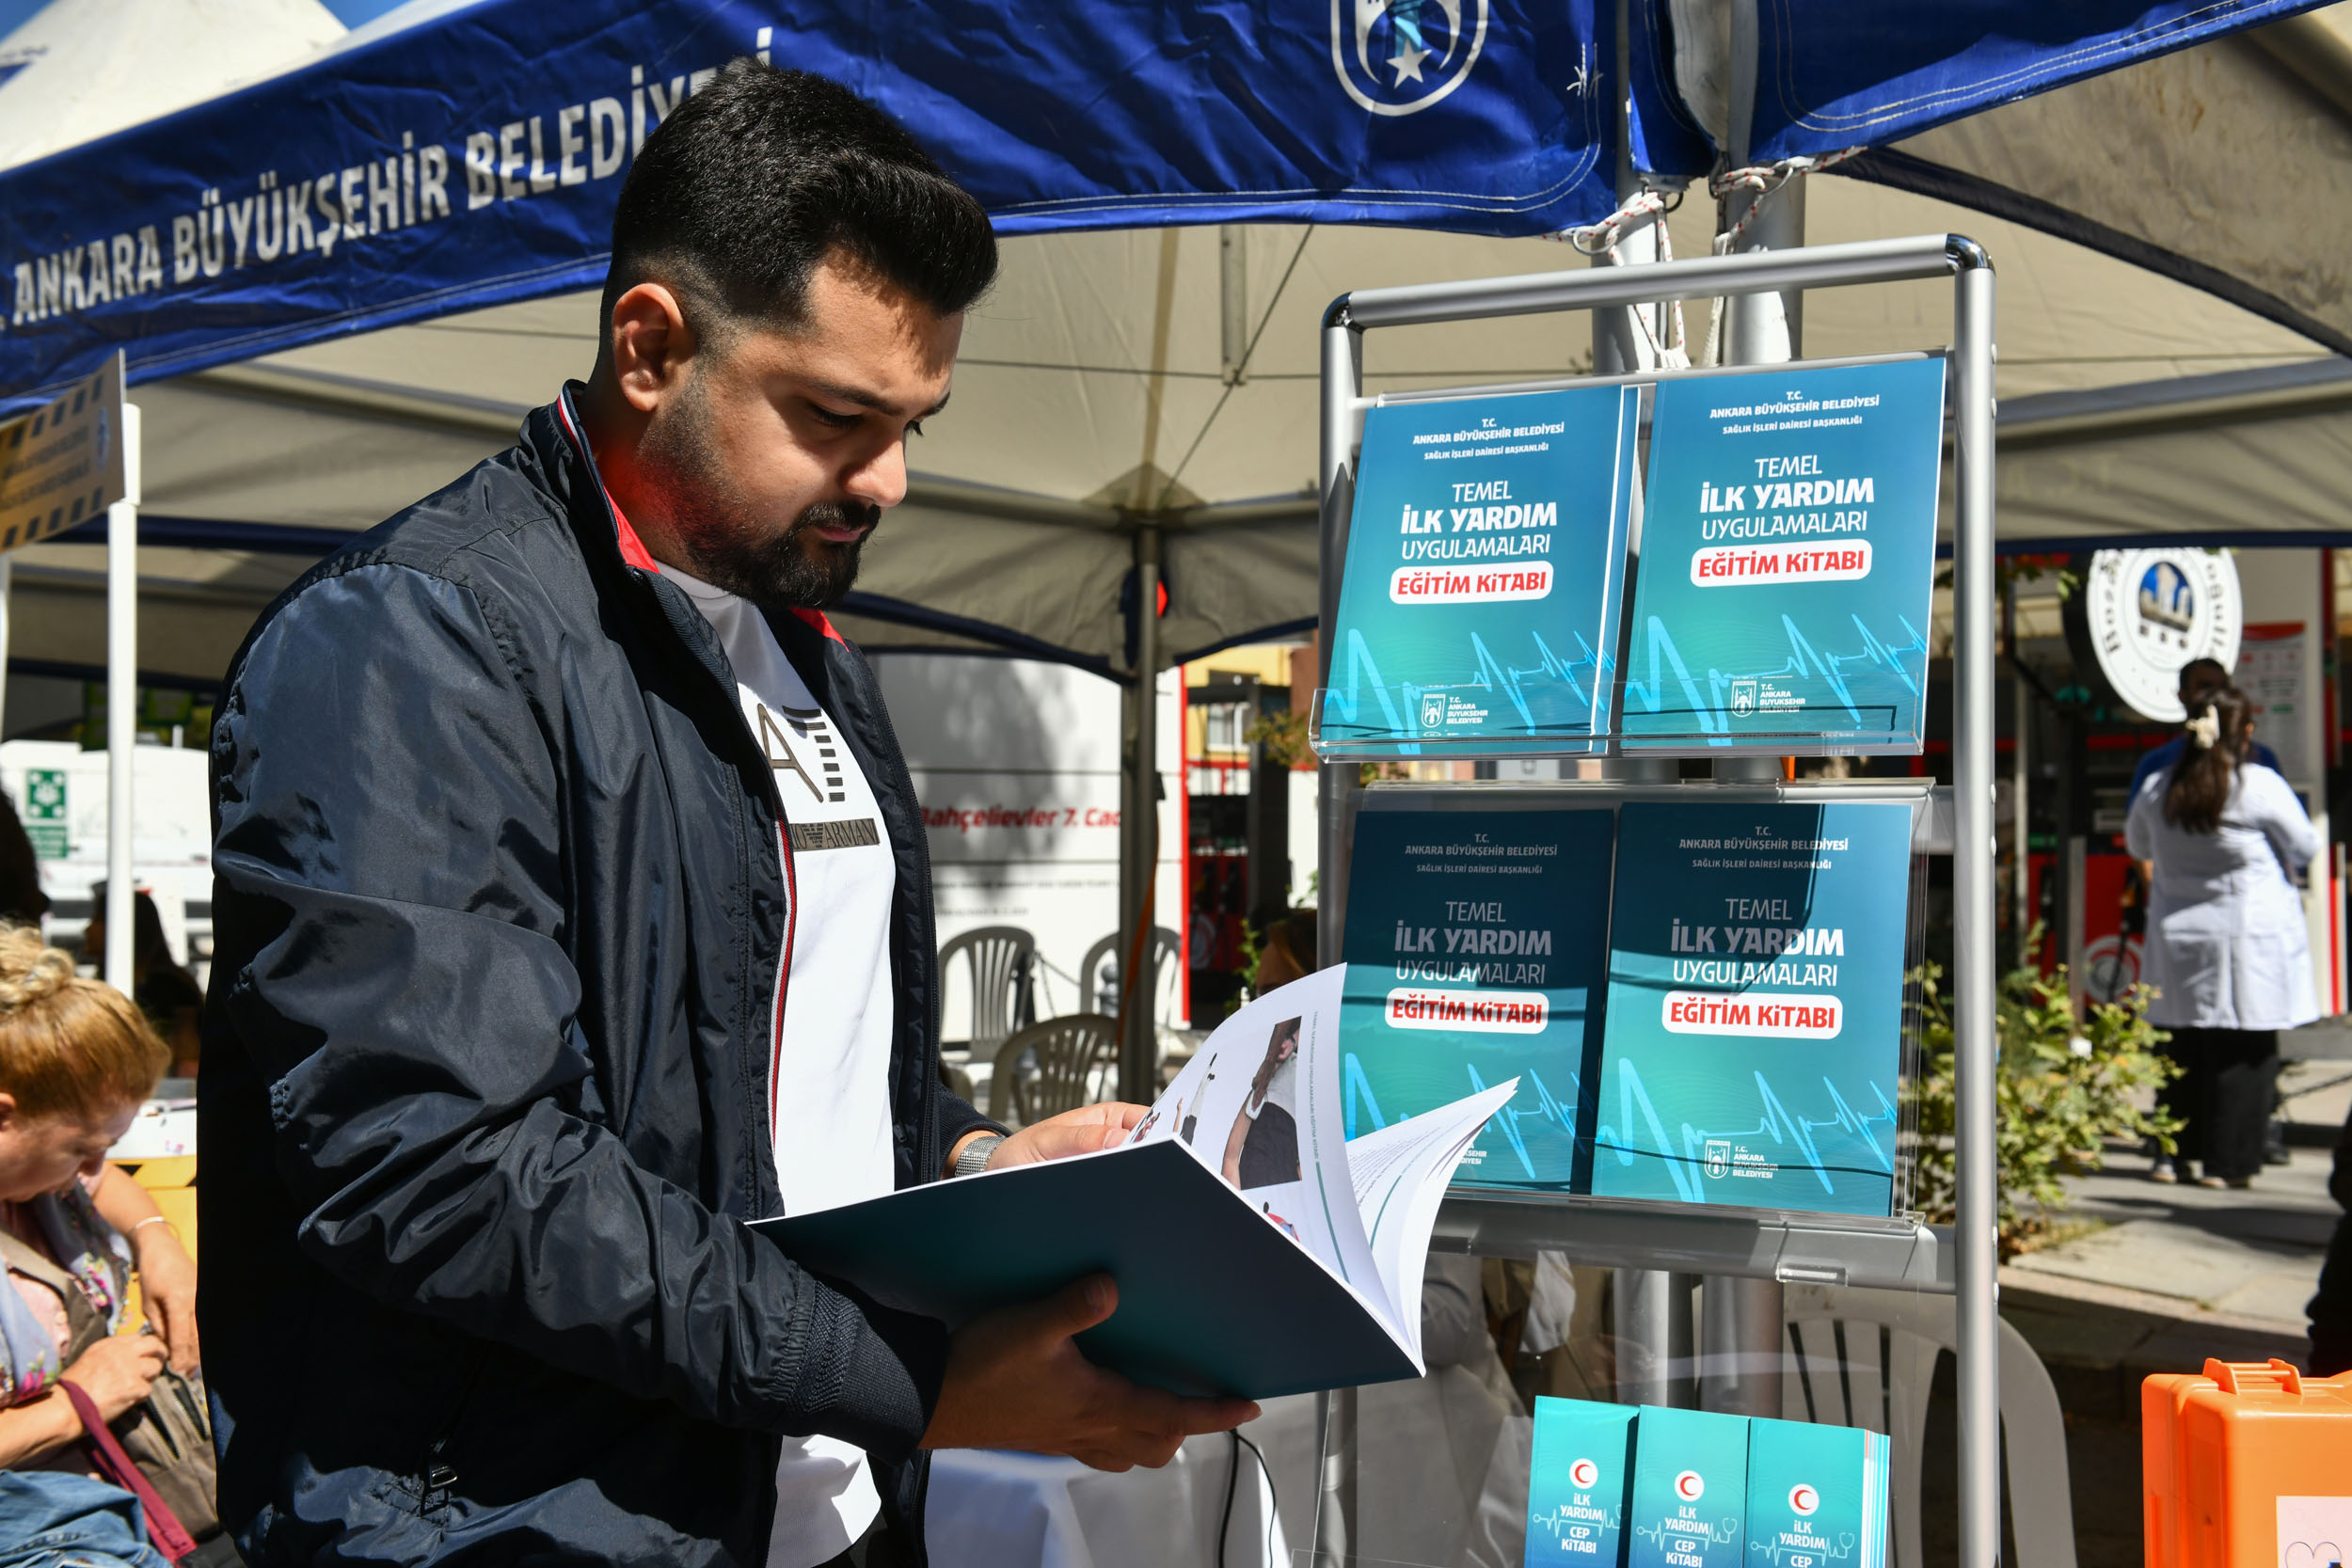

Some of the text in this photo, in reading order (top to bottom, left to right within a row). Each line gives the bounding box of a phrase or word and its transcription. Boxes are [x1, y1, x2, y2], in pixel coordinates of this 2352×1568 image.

[12, 225, 163, 326] ANKARA
[172, 130, 451, 284] BÜYÜKŞEHİR
[1709, 394, 1880, 419] ANKARA BÜYÜKŞEHİR BELEDİYESİ
[1787, 390, 1804, 401] T.C.
[1413, 421, 1565, 445] ANKARA BÜYÜKŞEHİR BELEDİYESİ
[1482, 418, 1497, 428] T.C.
[1723, 422, 1752, 435] SAĞLIK
[1813, 415, 1863, 428] BAŞKANLIĞI
[1423, 449, 1450, 460] SAĞLIK
[1505, 441, 1549, 454] BAŞKANLIĞI
[1755, 454, 1822, 479] TEMEL
[1452, 481, 1513, 502] TEMEL
[1700, 477, 1875, 514] İLK YARDIM
[1401, 501, 1558, 534] İLK YARDIM
[1702, 510, 1867, 540] UYGULAMALARI
[1402, 533, 1551, 560] UYGULAMALARI
[1698, 550, 1779, 578] EĞİTİM
[1397, 571, 1470, 595] EĞİTİM
[823, 818, 880, 848] ARMANI
[1474, 833, 1489, 843] T.C.
[1755, 826, 1772, 836] T.C.
[1405, 844, 1558, 858] ANKARA BÜYÜKŞEHİR BELEDİYESİ
[1678, 837, 1849, 851] ANKARA BÜYÜKŞEHİR BELEDİYESİ
[1416, 863, 1442, 872] SAĞLIK
[1498, 864, 1543, 876] BAŞKANLIĞI
[1692, 858, 1721, 867] SAĞLIK
[1783, 859, 1832, 870] BAŞKANLIĞI
[1445, 901, 1506, 923] TEMEL
[1725, 898, 1792, 921] TEMEL
[1394, 919, 1552, 956] İLK YARDIM
[1671, 917, 1845, 956] İLK YARDIM
[1395, 959, 1546, 985] UYGULAMALARI
[1673, 960, 1837, 987] UYGULAMALARI
[1392, 993, 1466, 1022] EĞİTİM
[1670, 996, 1751, 1026] EĞİTİM
[1734, 1153, 1765, 1162] ANKARA
[1560, 1505, 1603, 1522] YARDIM
[1569, 1526, 1590, 1539] CEP
[1664, 1517, 1709, 1535] YARDIM
[1675, 1540, 1696, 1553] CEP
[1779, 1532, 1825, 1550] YARDIM
[1790, 1555, 1813, 1568] CEP
